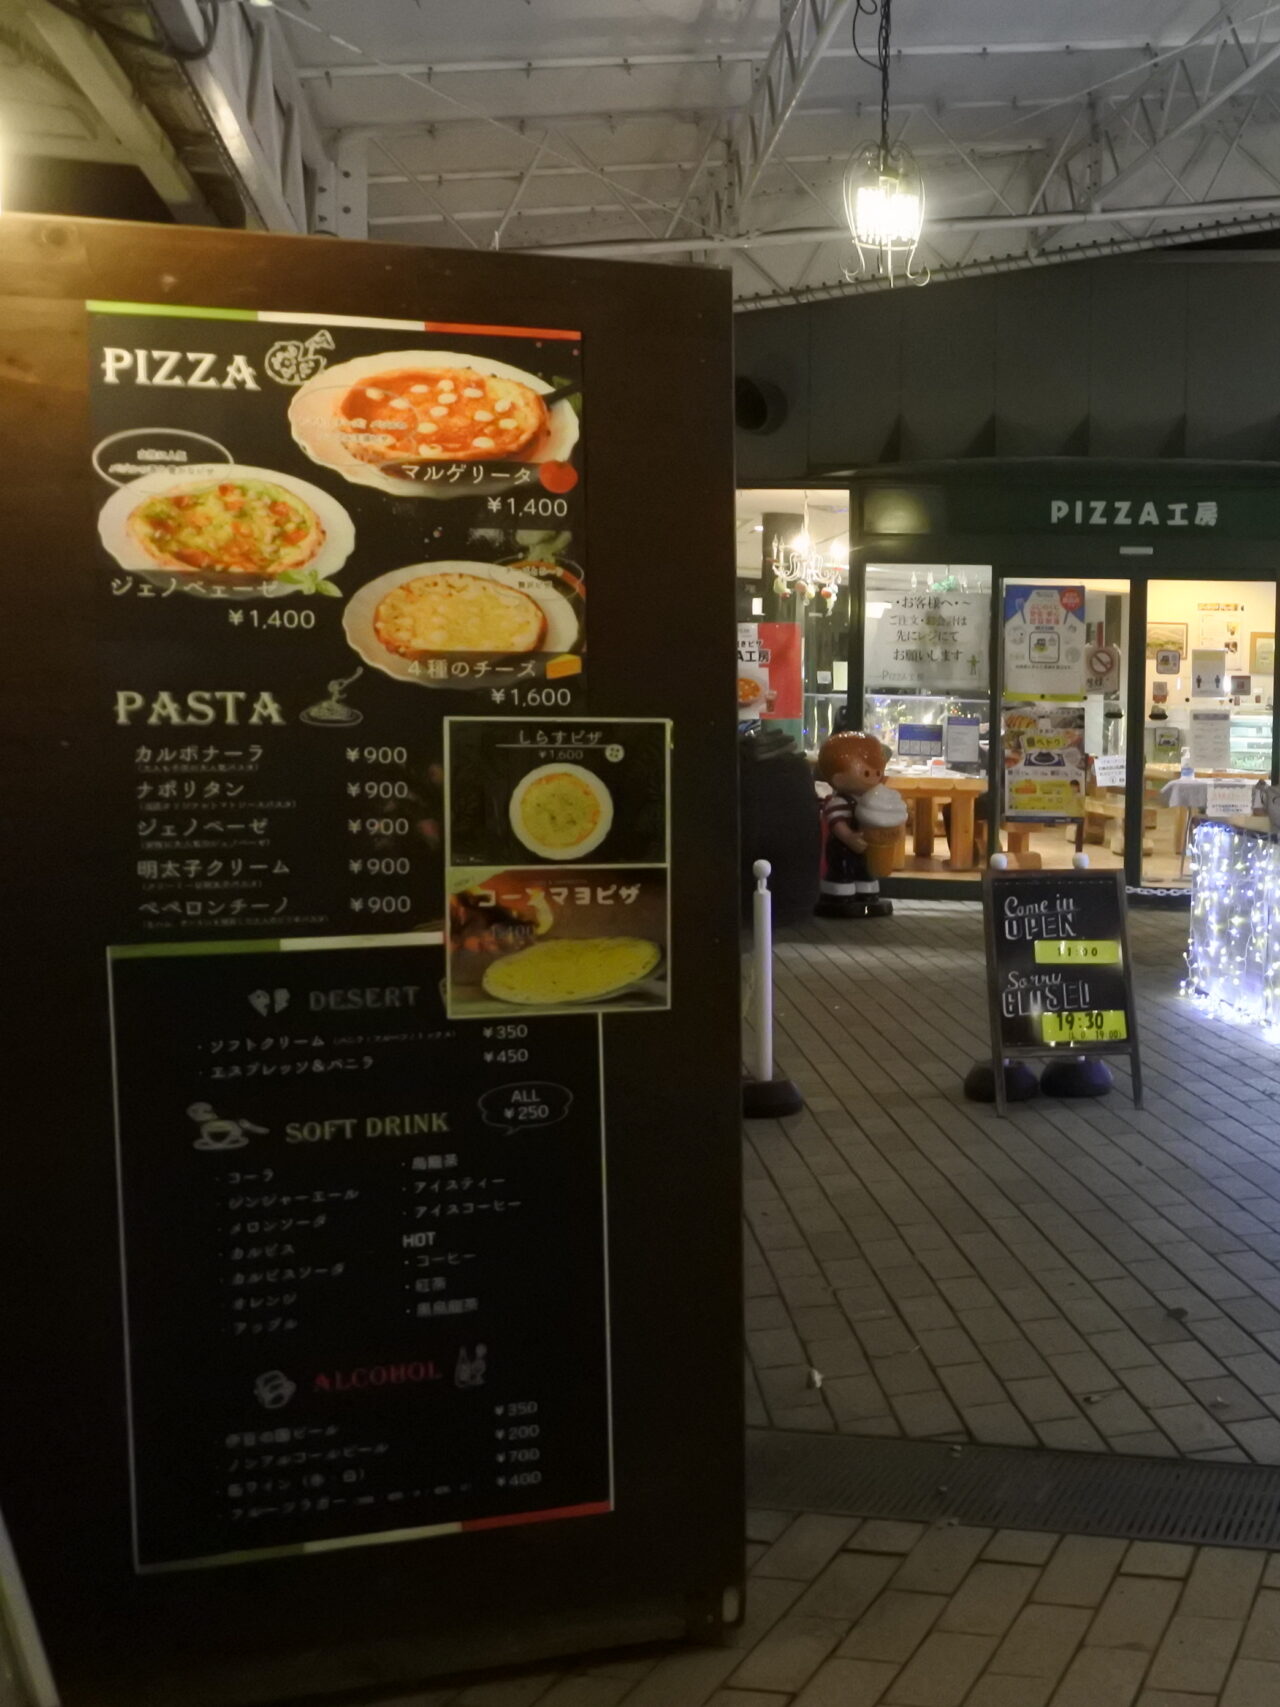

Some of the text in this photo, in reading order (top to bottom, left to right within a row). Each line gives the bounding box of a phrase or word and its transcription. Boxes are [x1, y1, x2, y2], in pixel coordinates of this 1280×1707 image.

[101, 347, 262, 391] PIZZA
[401, 464, 532, 485] マルゲリータ
[488, 497, 568, 517] ¥1,400
[1051, 500, 1218, 526] PIZZA工房
[228, 608, 315, 629] ¥1,400
[114, 690, 287, 725] PASTA
[491, 688, 571, 707] ¥1,600
[519, 729, 603, 745] しらすピザ
[135, 744, 264, 763] カルボナーラ
[345, 746, 408, 764] ¥900
[136, 779, 245, 799] ナポリタン
[346, 781, 409, 798] ¥900
[137, 817, 269, 837] ジェノベーゼ
[348, 817, 410, 835] ¥900
[136, 859, 291, 879] 明太子クリーム
[349, 857, 411, 876] ¥900
[350, 895, 412, 913] ¥900
[1004, 895, 1049, 917] Come
[1004, 912, 1077, 940] OPEN
[1007, 970, 1063, 991] Sorry
[308, 983, 421, 1012] DESERT
[1057, 1012, 1105, 1031] 19:30
[483, 1024, 529, 1040] ¥350
[483, 1048, 529, 1064] ¥450
[511, 1089, 541, 1103] ALL
[503, 1105, 550, 1120] ¥250
[285, 1112, 450, 1144] SOFT DRINK
[402, 1231, 437, 1249] HOT
[312, 1361, 443, 1393] ALCOHOL
